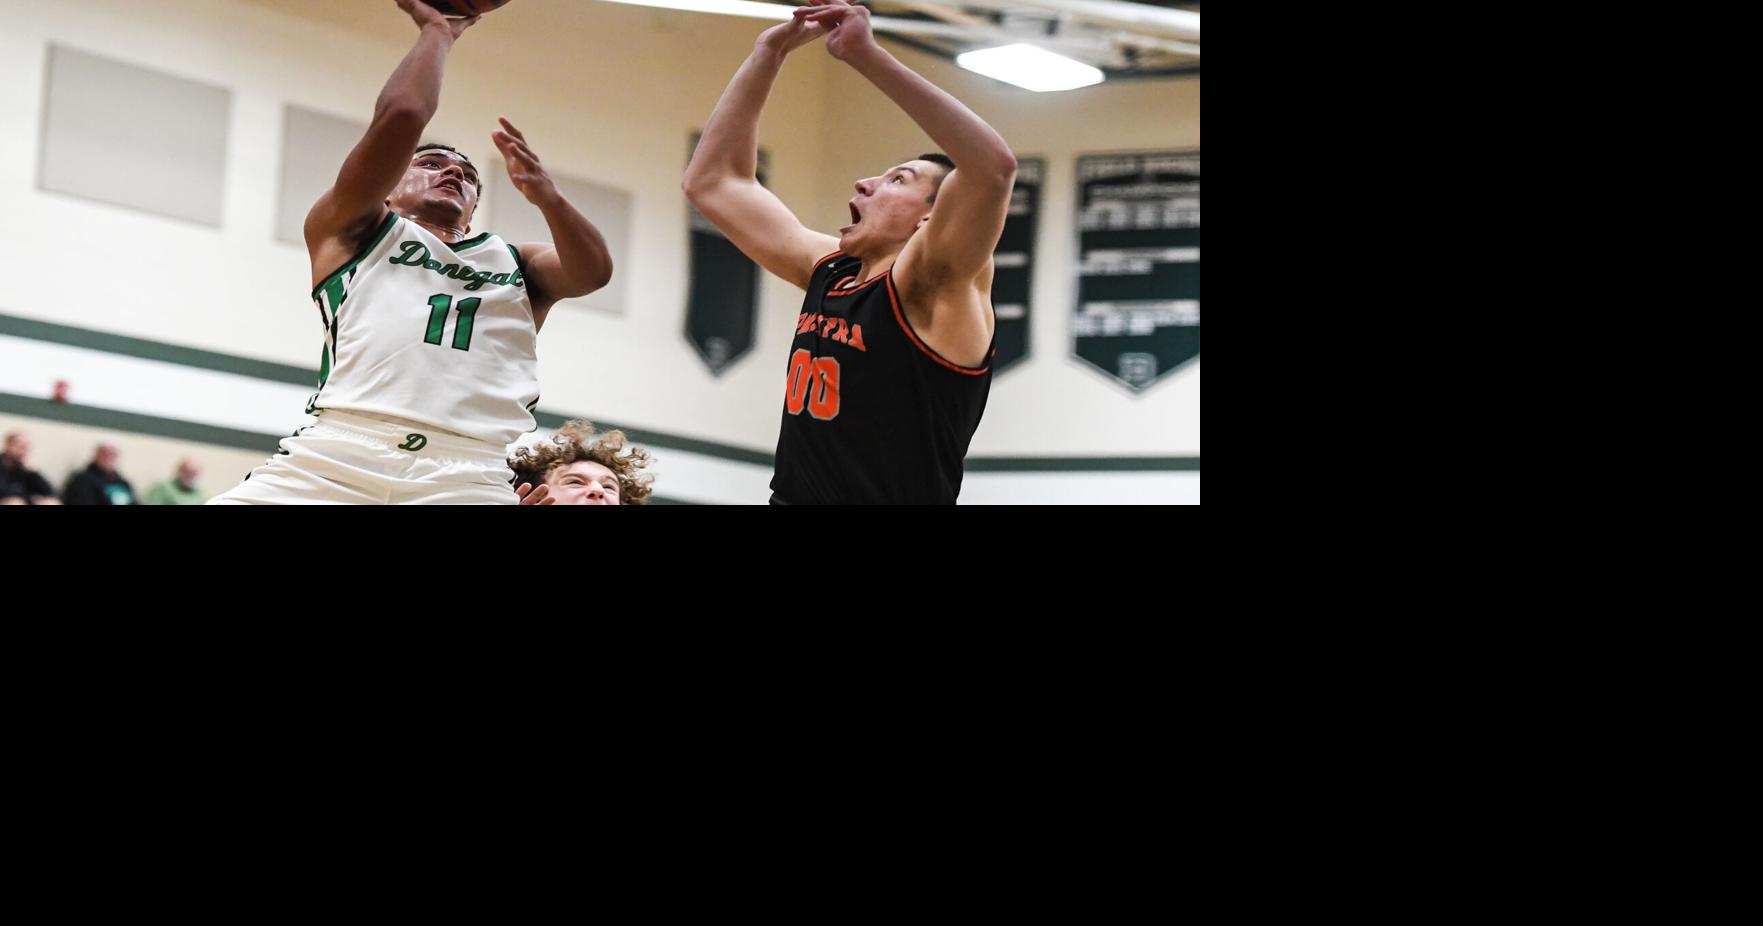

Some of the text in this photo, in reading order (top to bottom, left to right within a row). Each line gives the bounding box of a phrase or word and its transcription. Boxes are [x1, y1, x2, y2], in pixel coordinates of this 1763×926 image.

[389, 240, 523, 290] Donegal
[424, 293, 481, 351] 11
[786, 348, 840, 420] 00
[398, 433, 427, 451] D
